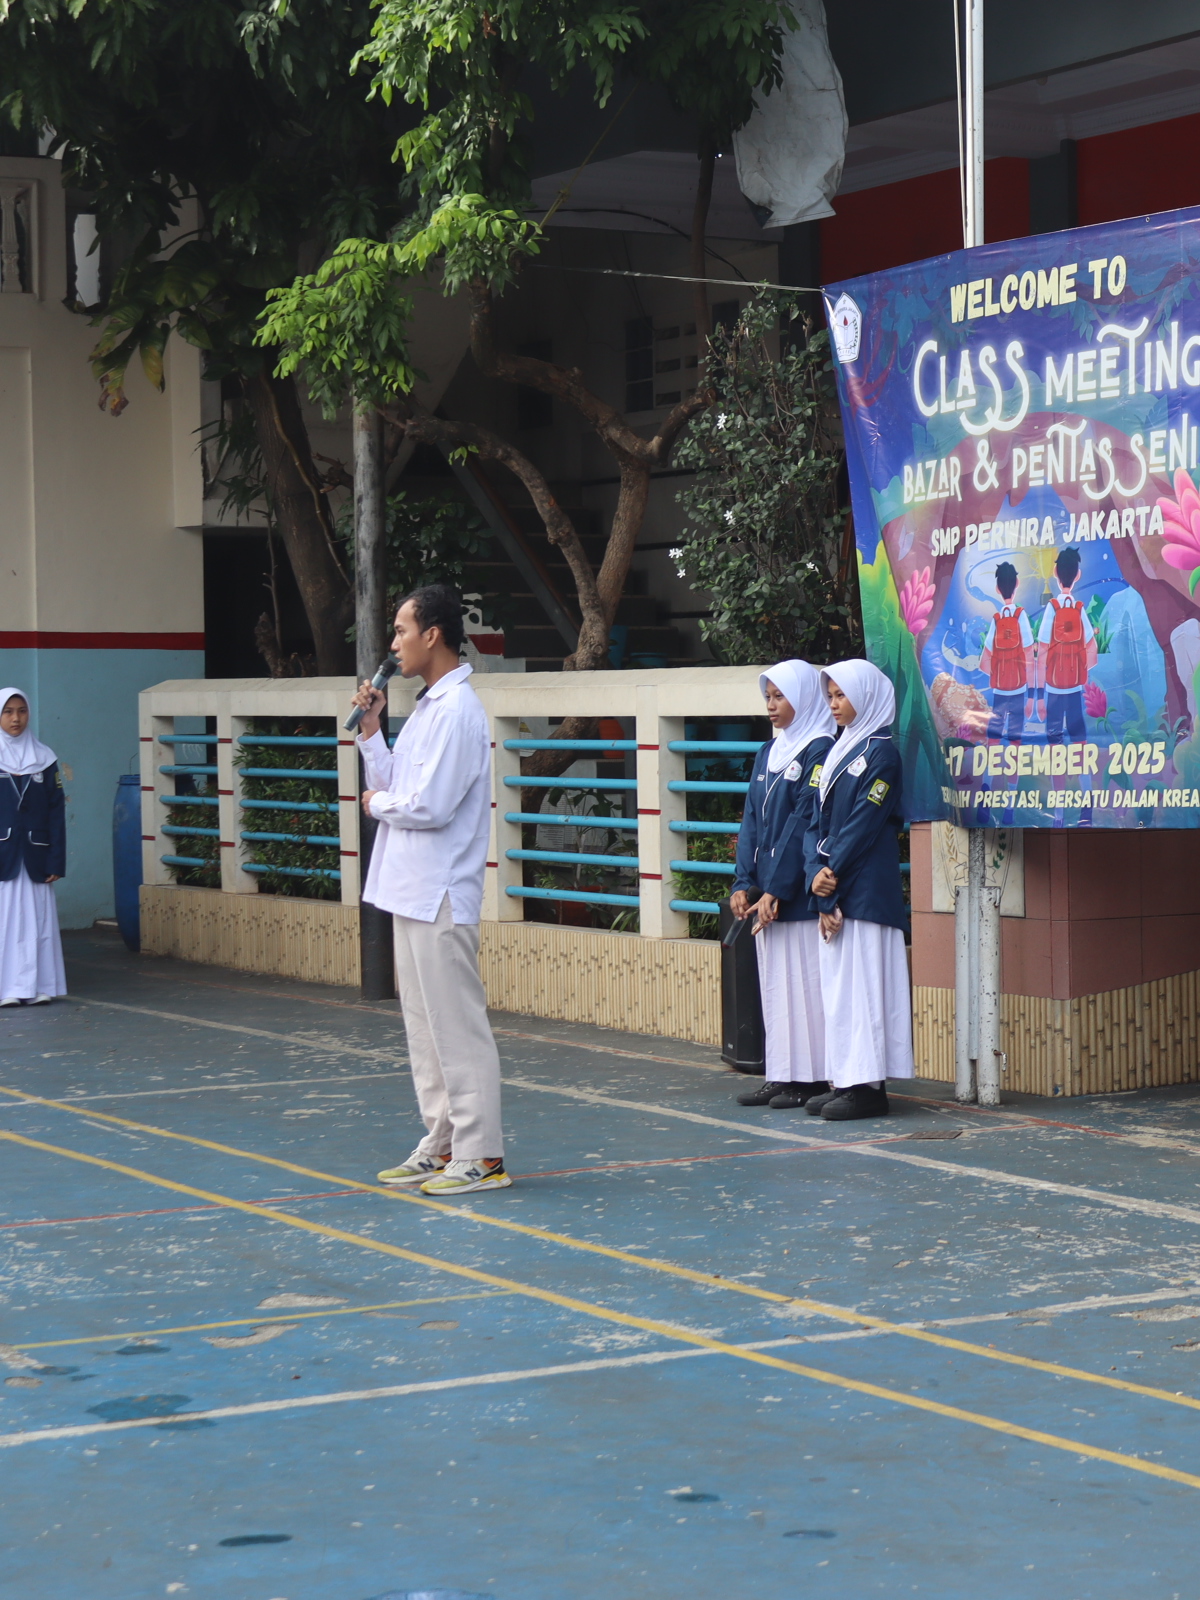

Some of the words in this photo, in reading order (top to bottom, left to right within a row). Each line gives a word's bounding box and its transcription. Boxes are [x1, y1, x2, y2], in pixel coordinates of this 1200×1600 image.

[950, 263, 1078, 323] WELCOME
[1088, 255, 1127, 300] TO
[913, 339, 1030, 435] CLASS
[903, 456, 962, 504] BAZAR
[972, 438, 999, 492] &
[1012, 418, 1115, 500] PENTAS
[1113, 412, 1198, 497] SENI
[931, 525, 960, 557] SMP
[965, 515, 1055, 552] PERWIRA
[1062, 504, 1165, 543] JAKARTA
[972, 743, 1099, 776] DESEMBER
[1108, 741, 1166, 776] 2025
[973, 789, 1043, 810] PRESTASI,
[1046, 789, 1109, 809] BERSATU
[1112, 789, 1160, 809] DALAM
